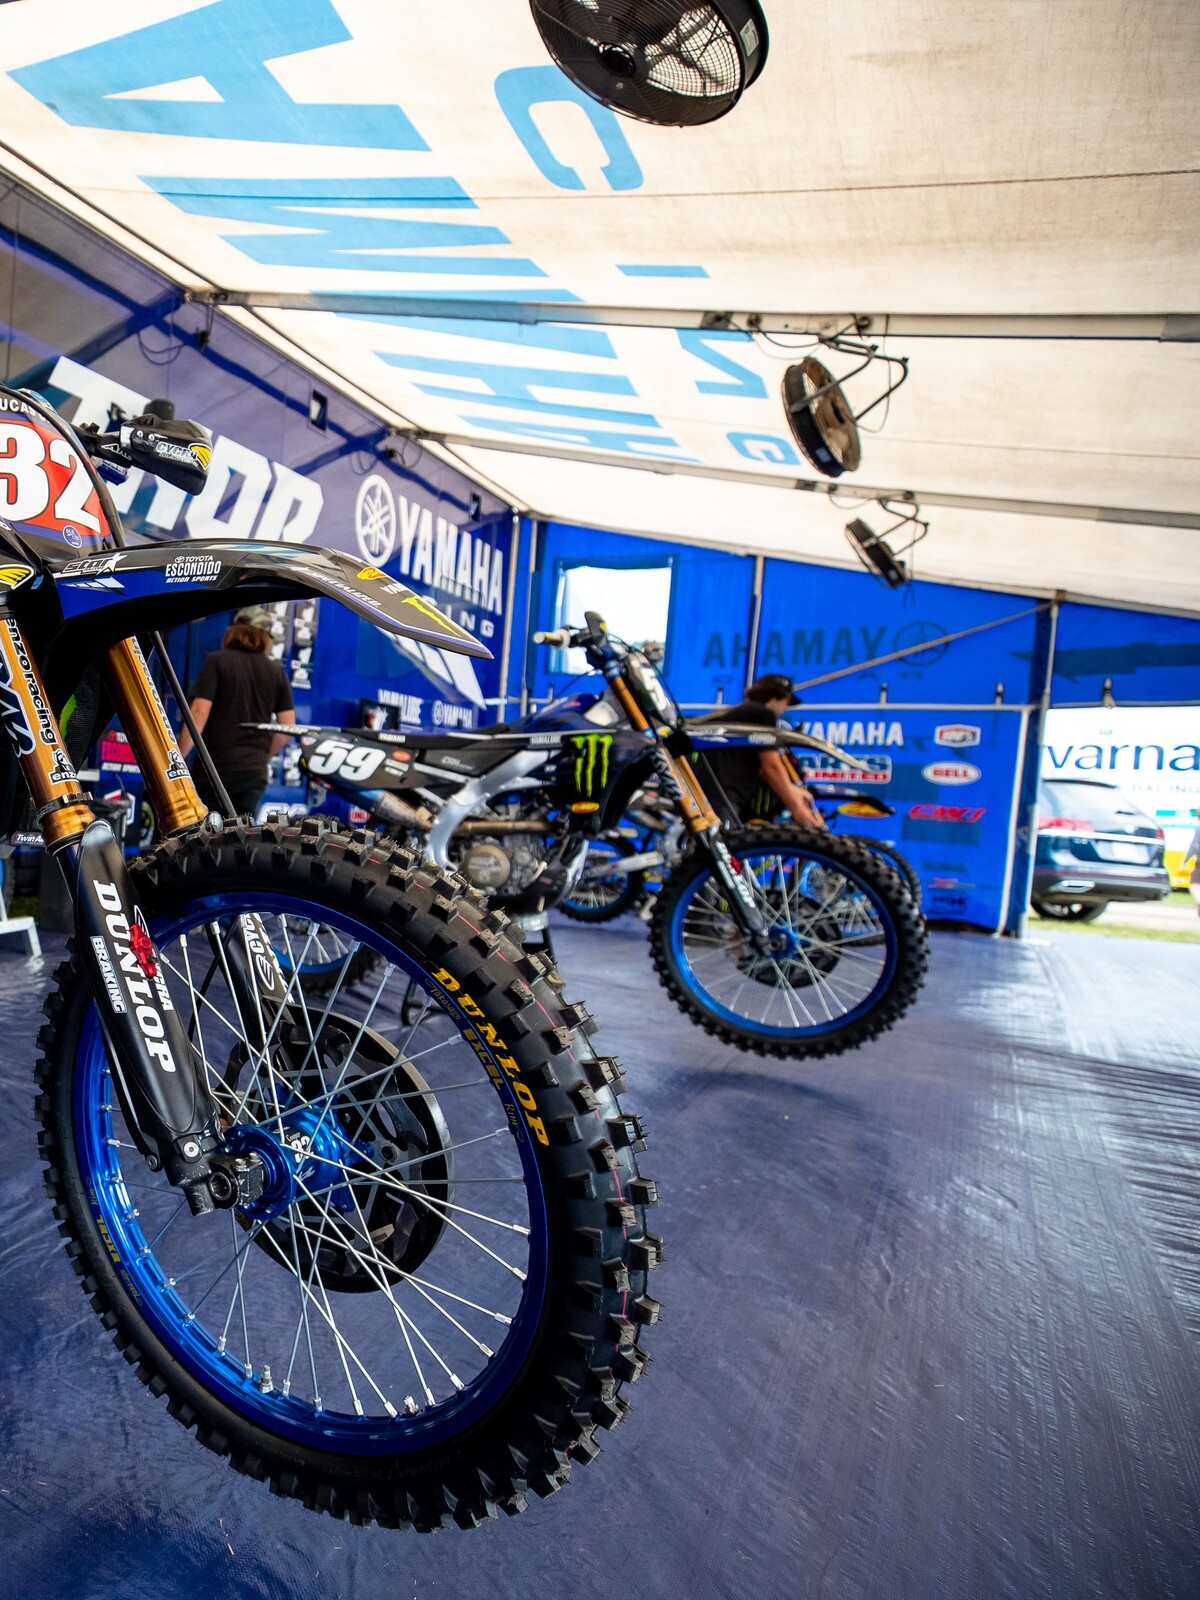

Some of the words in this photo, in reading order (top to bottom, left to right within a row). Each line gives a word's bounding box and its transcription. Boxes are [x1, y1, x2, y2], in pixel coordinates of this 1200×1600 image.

[165, 560, 222, 577] ESCONDIDO
[398, 494, 503, 616] YAMAHA
[308, 739, 386, 781] 59
[1047, 743, 1200, 771] varna
[91, 936, 126, 1012] BRAKING
[93, 879, 176, 1073] DUNLOP
[431, 967, 549, 1147] DUNLOP
[463, 1027, 505, 1091] EXCEL
[96, 1216, 121, 1263] EXCEL
